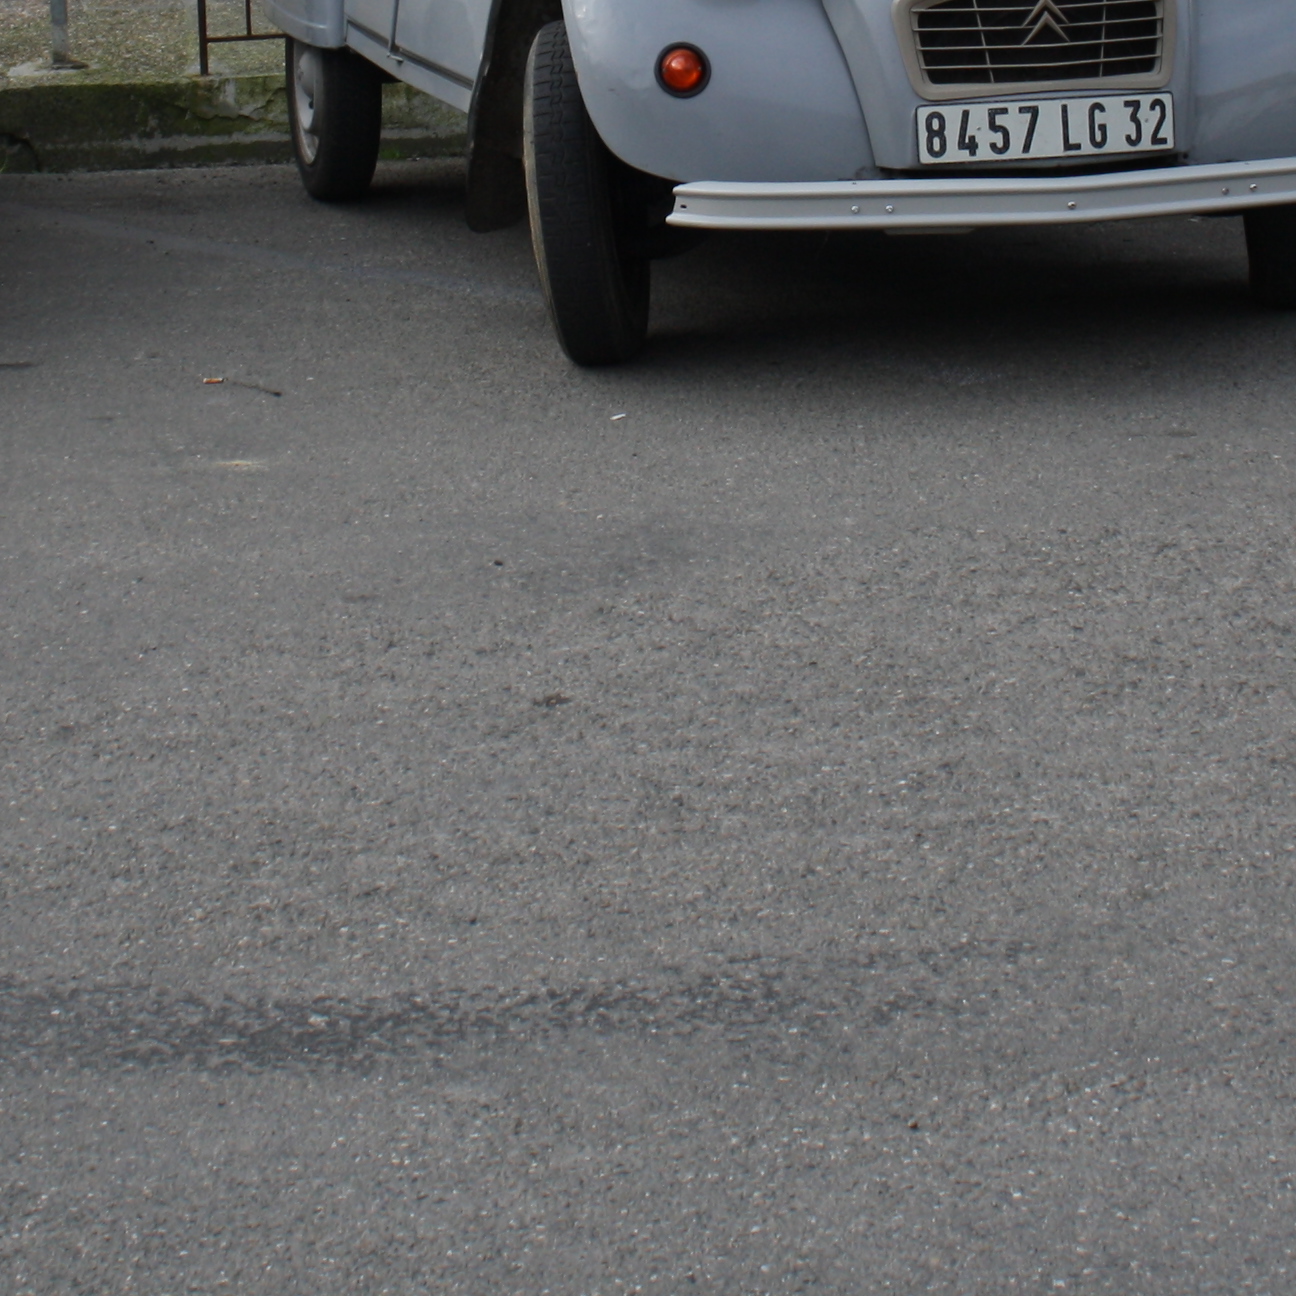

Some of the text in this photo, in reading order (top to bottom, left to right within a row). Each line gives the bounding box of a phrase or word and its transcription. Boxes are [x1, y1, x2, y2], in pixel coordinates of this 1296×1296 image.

[925, 98, 1168, 158] 8457 LG 32
